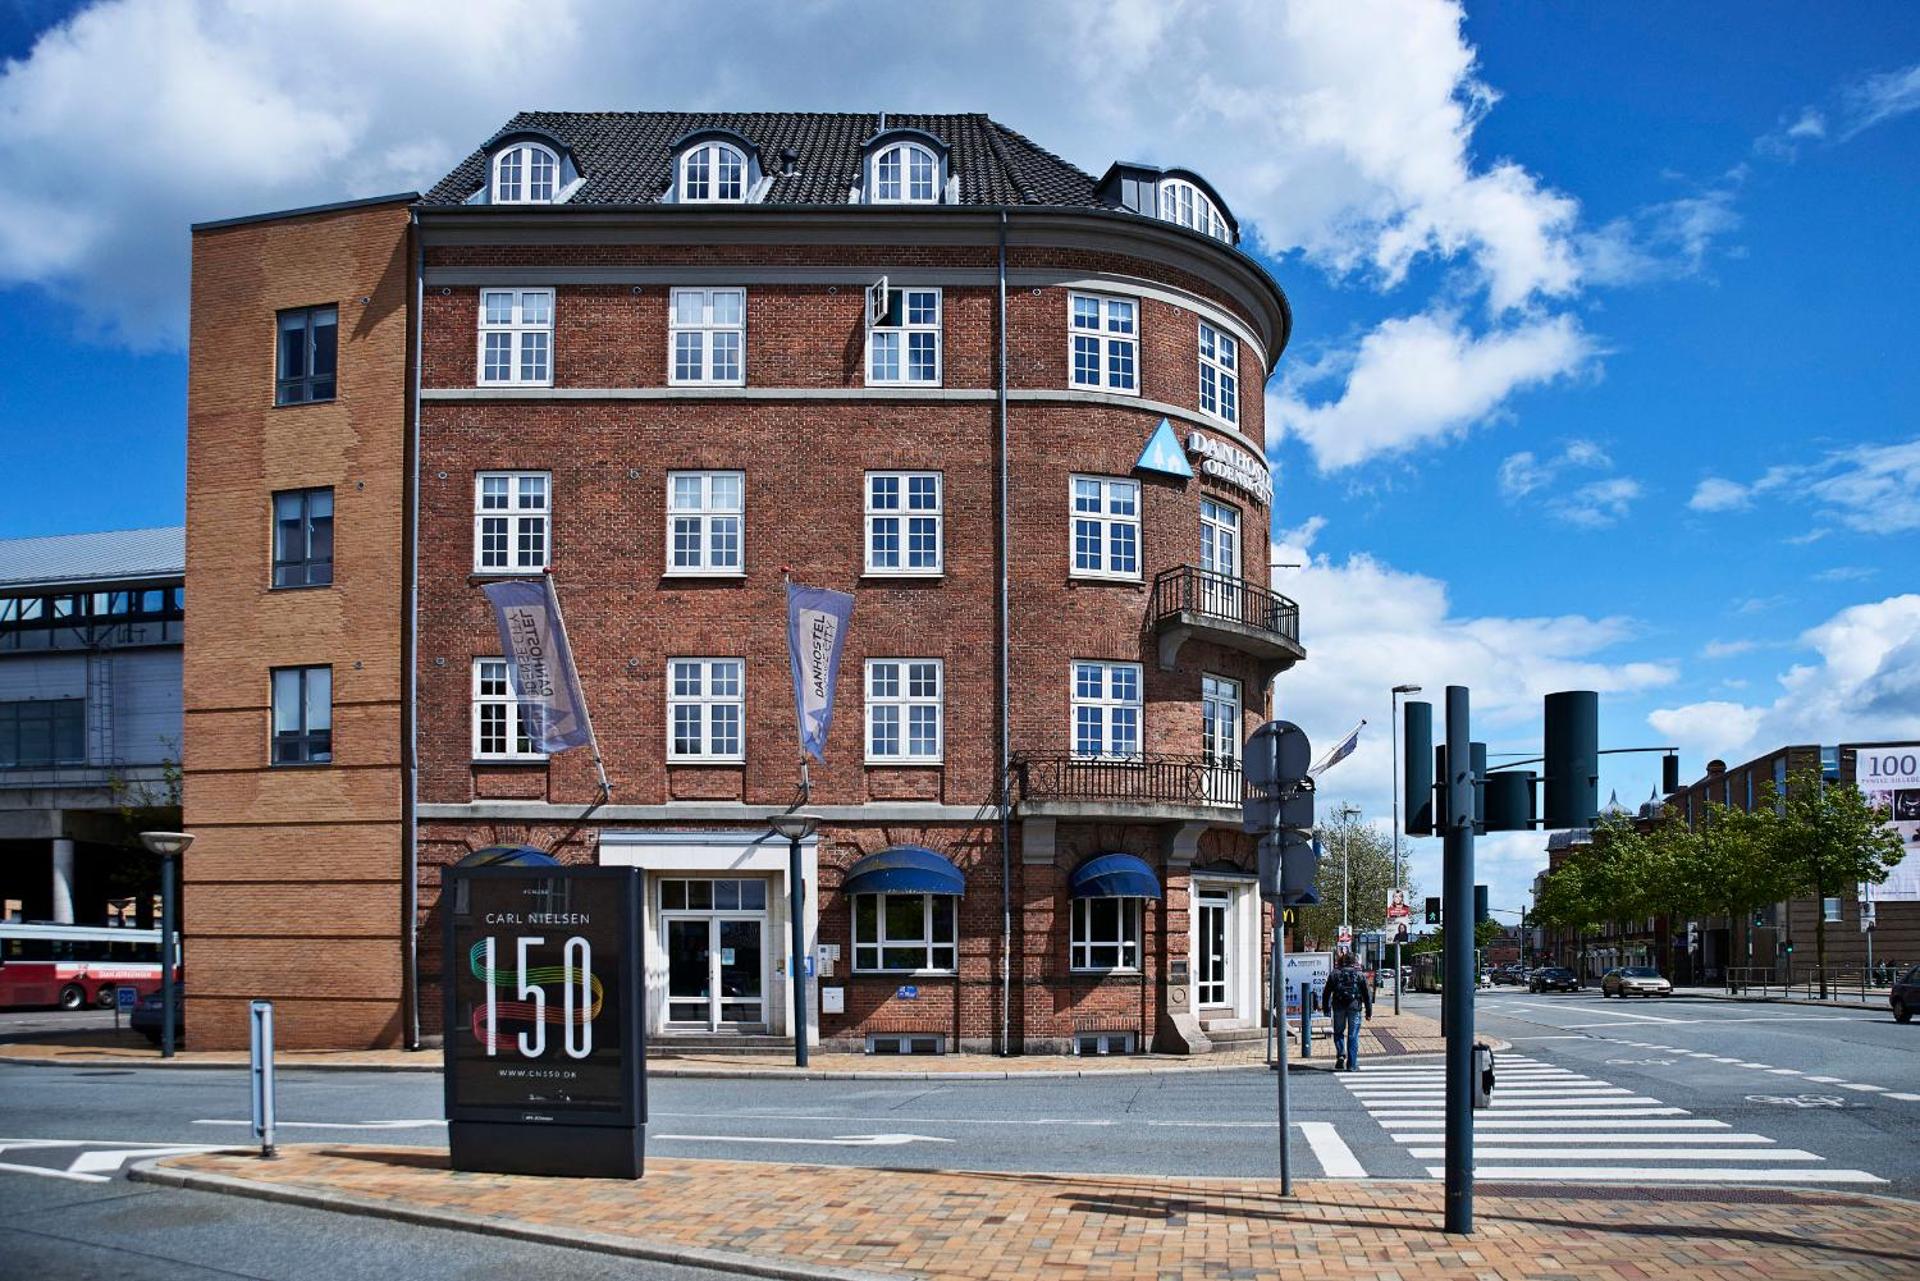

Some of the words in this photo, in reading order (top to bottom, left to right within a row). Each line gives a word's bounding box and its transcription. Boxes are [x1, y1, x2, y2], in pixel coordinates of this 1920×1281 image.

[812, 615, 825, 698] DANHOSTEL
[1869, 755, 1917, 776] 100
[486, 913, 522, 924] CARL
[529, 913, 590, 925] NIELSEN
[486, 936, 592, 1060] 150
